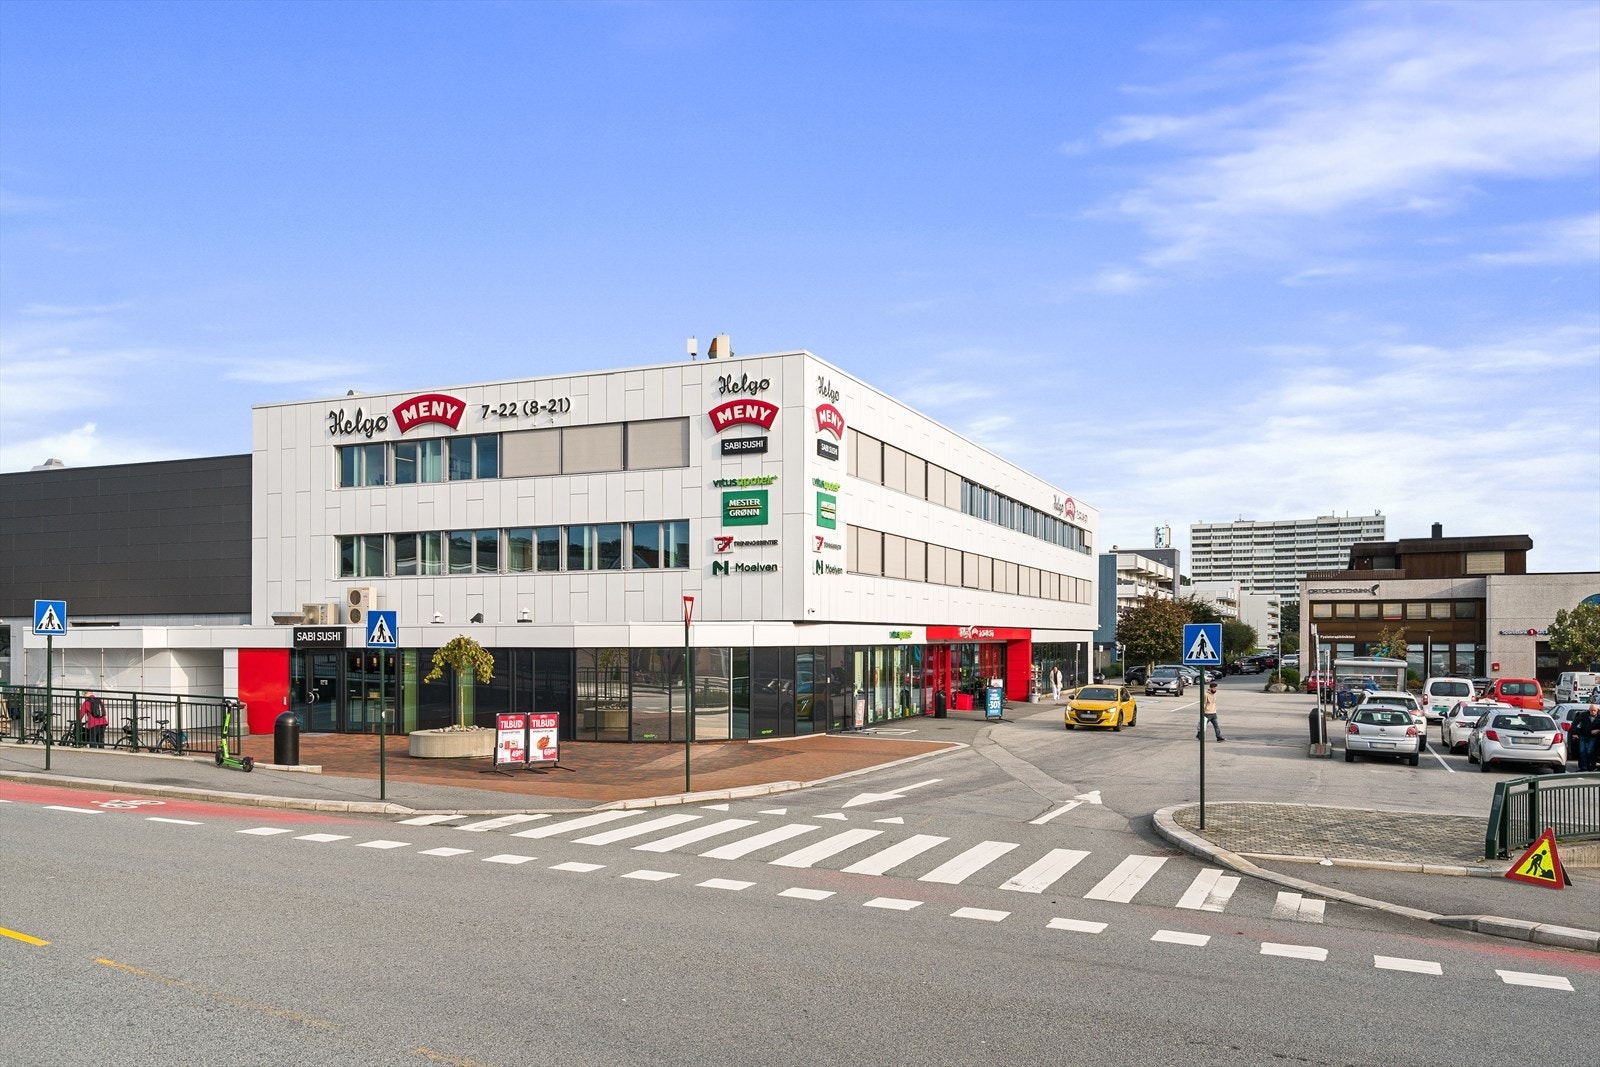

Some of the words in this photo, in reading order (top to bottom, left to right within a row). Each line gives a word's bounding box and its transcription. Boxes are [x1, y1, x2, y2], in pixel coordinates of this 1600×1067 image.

[718, 372, 771, 395] Helgø
[329, 407, 389, 438] Helgø
[401, 401, 459, 424] MENY
[482, 403, 517, 418] 7-22
[523, 397, 571, 416] (8-21)
[716, 404, 772, 424] MENY
[819, 409, 842, 431] MENY
[724, 441, 741, 450] SABI
[742, 440, 764, 449] SUSHI
[729, 499, 760, 507] MESTER
[735, 562, 778, 573] Moelven
[297, 631, 315, 641] SABI
[317, 631, 341, 641] SUSHI
[500, 720, 523, 729] TILBUD
[532, 719, 555, 728] TILBUD
